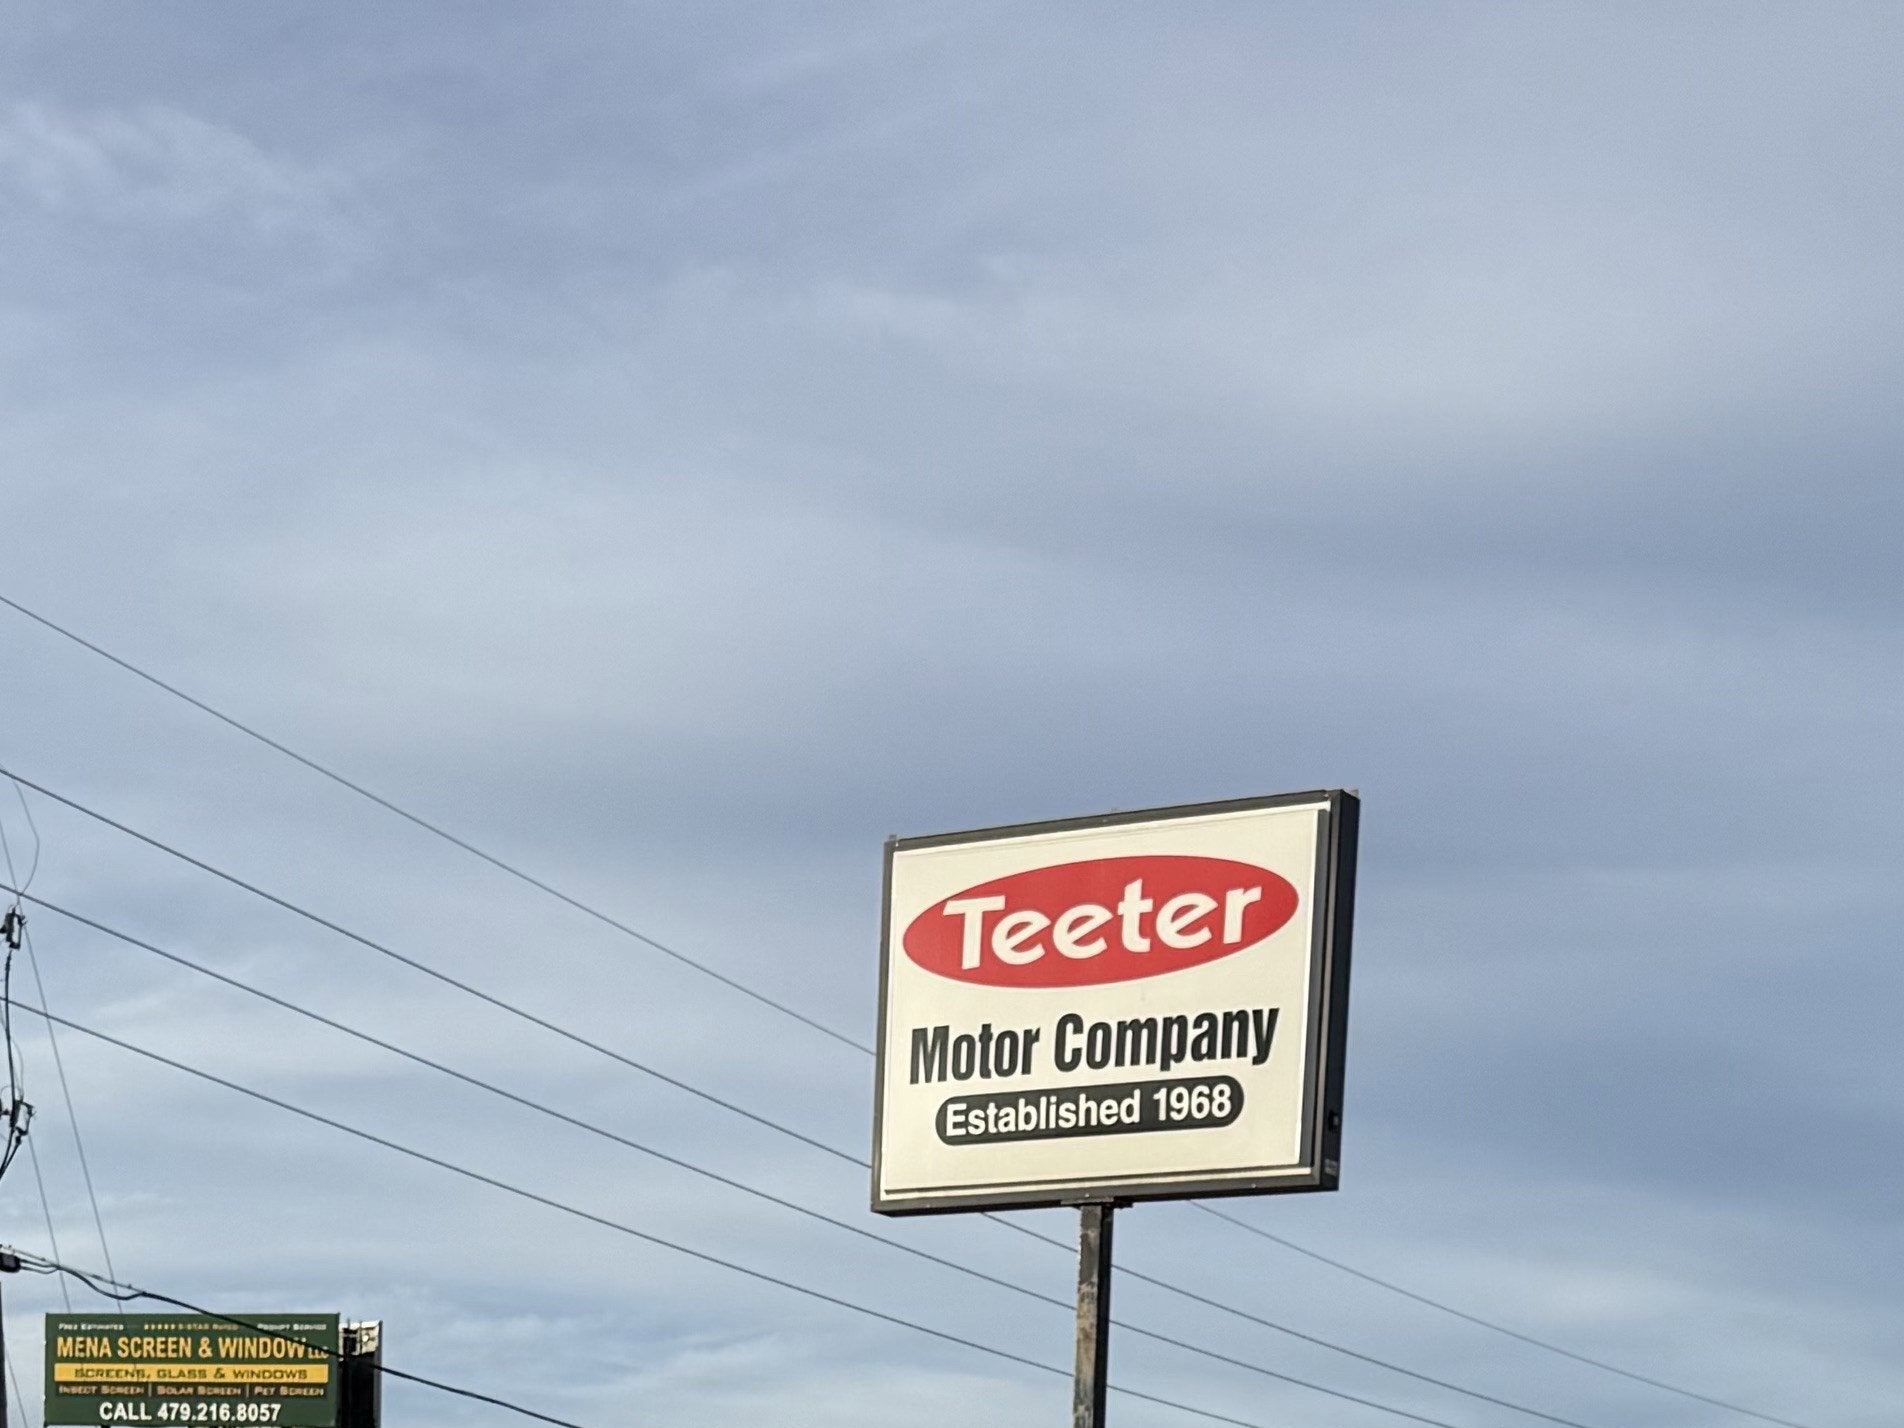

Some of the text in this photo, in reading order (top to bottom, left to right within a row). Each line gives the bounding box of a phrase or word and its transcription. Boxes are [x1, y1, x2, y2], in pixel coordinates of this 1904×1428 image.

[942, 877, 1263, 971] Teeter
[909, 1006, 1280, 1085] Motor Company
[944, 1083, 1232, 1137] Established 1968
[57, 1336, 112, 1358] MENA
[117, 1336, 192, 1358] SCREEN
[198, 1336, 213, 1358] &
[217, 1336, 305, 1359] WINDOW
[156, 1368, 207, 1379] GLASS
[213, 1367, 225, 1379] &
[232, 1369, 308, 1380] WINDOWS
[99, 1401, 282, 1422] CALL 479.216.8057
